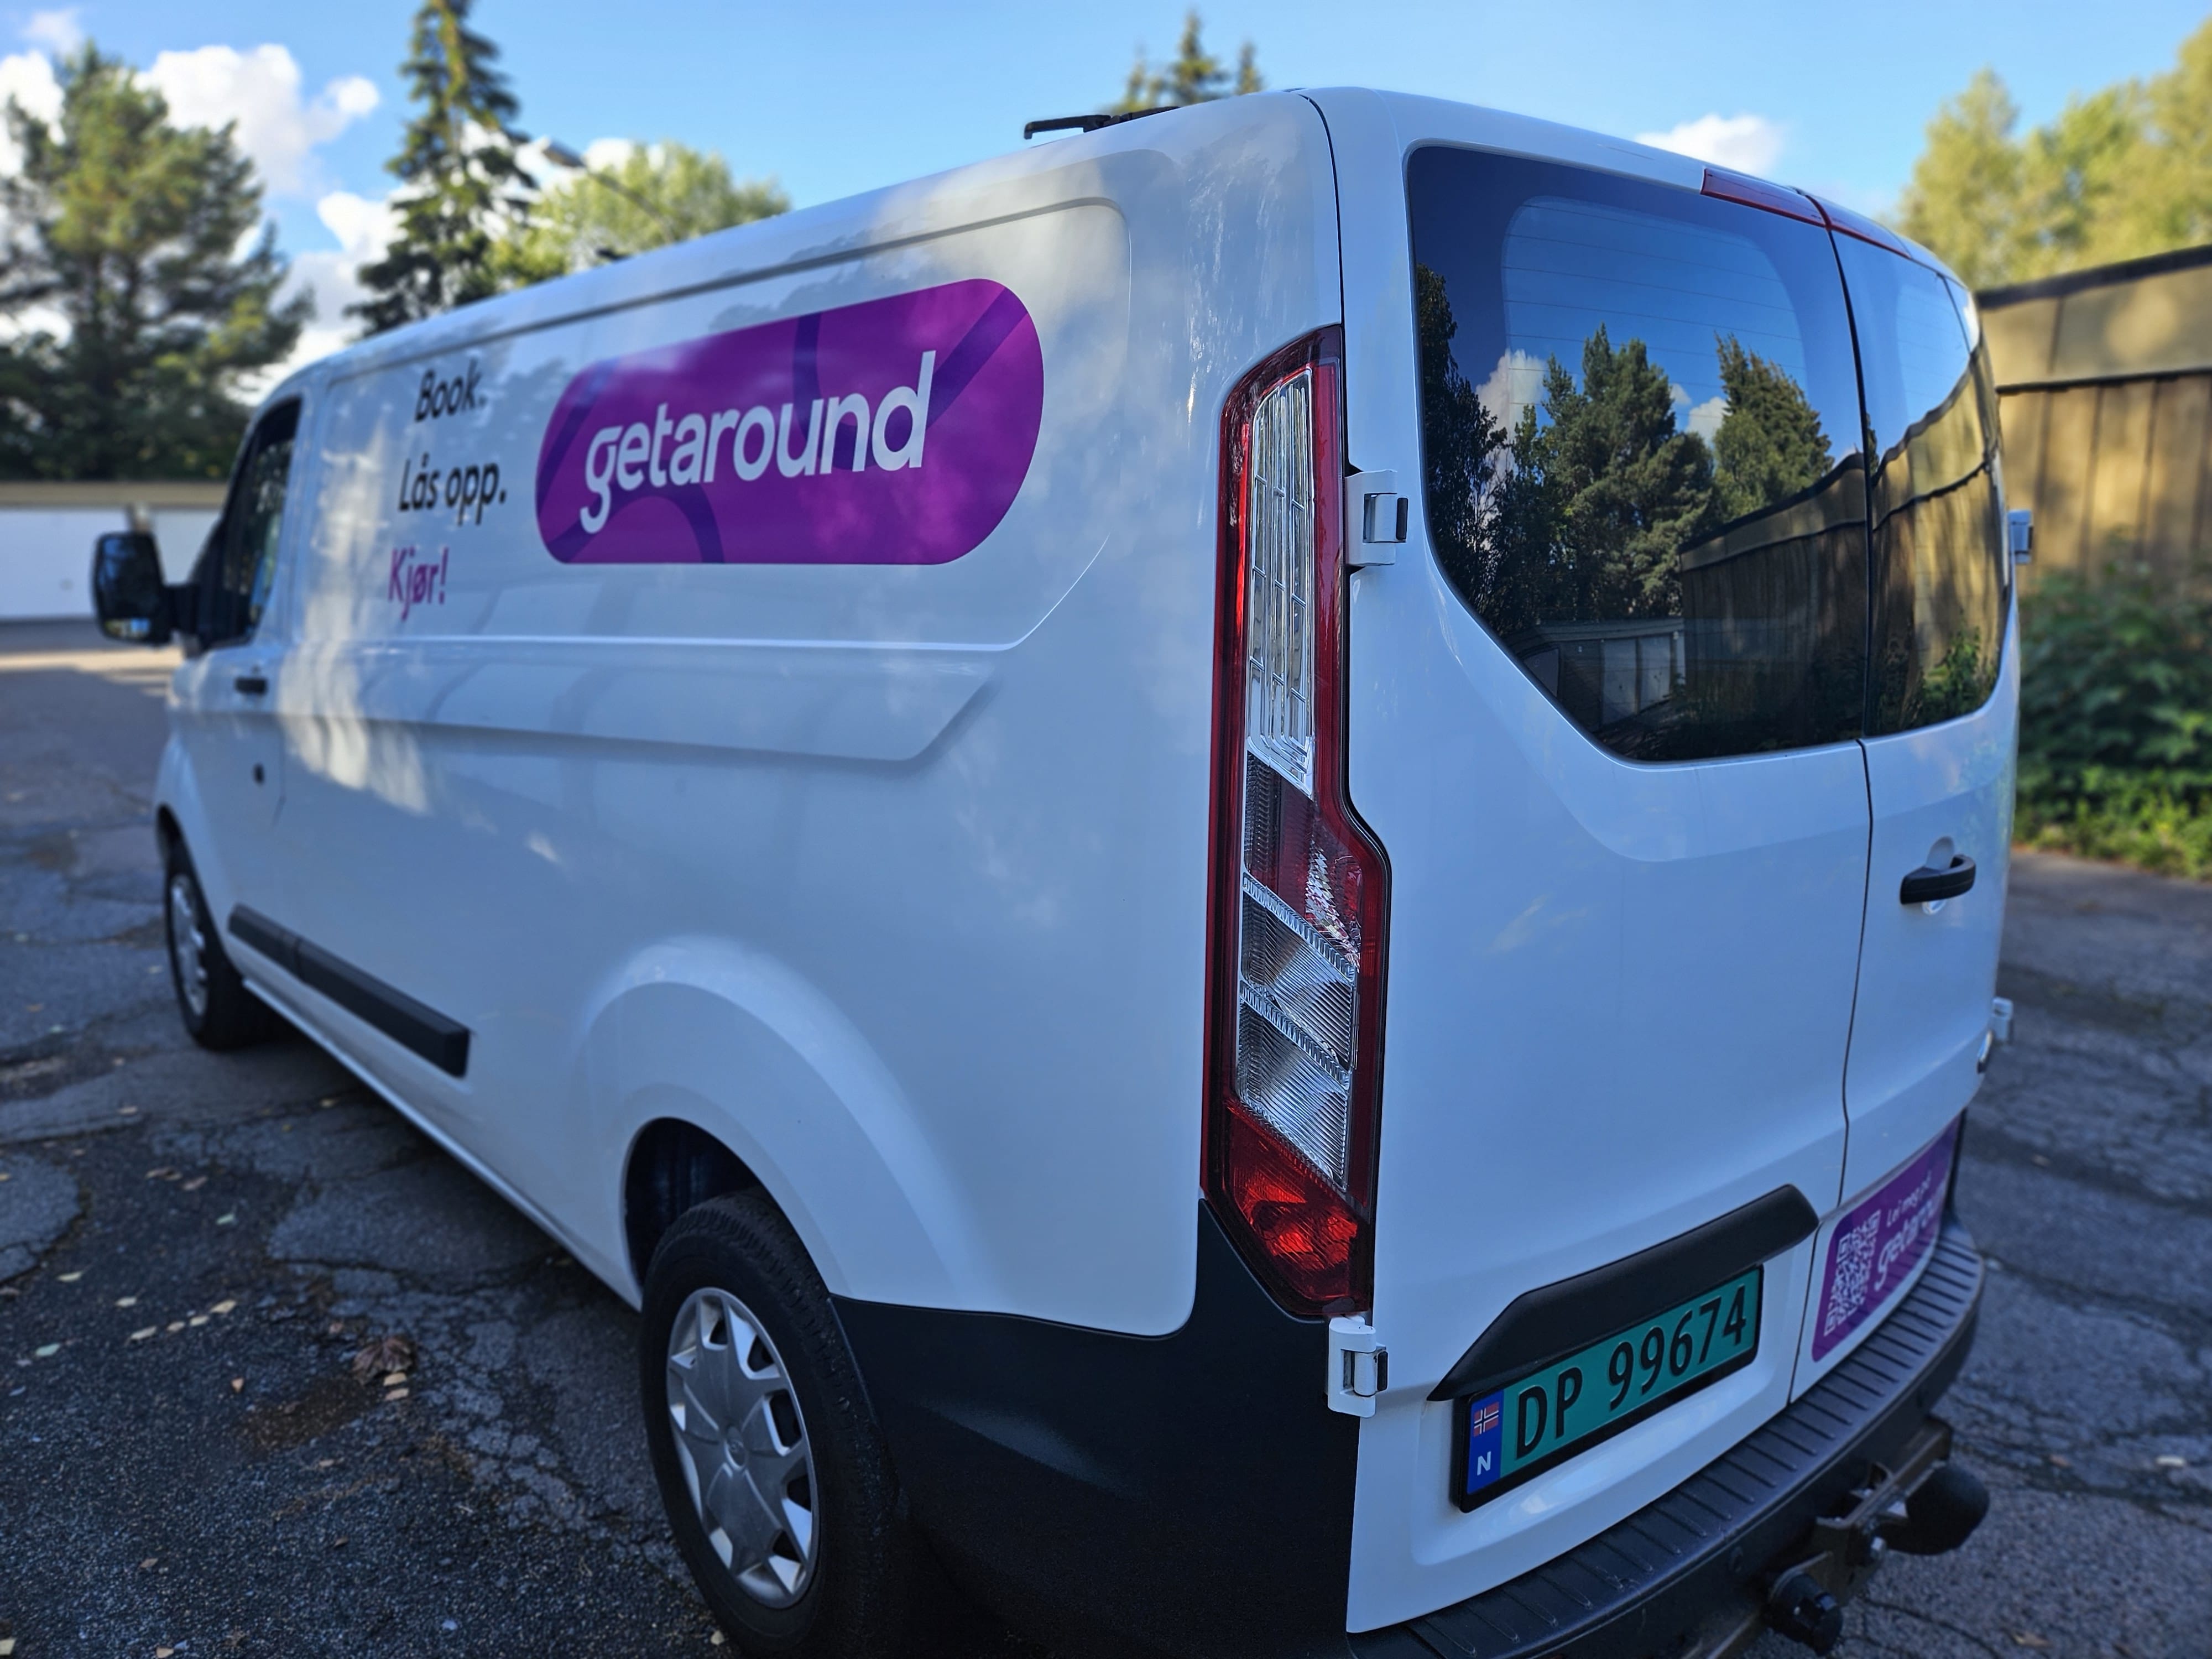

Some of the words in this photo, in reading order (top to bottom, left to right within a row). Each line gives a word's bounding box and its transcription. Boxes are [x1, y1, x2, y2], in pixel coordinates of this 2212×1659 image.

[414, 358, 488, 423] Book.
[580, 349, 937, 535] getaround
[398, 452, 440, 512] Lås
[445, 462, 506, 526] opp.
[388, 546, 449, 622] Kjør!
[1516, 1366, 1583, 1460] DP
[1607, 1284, 1747, 1411] 99674
[1477, 1451, 1491, 1476] N
